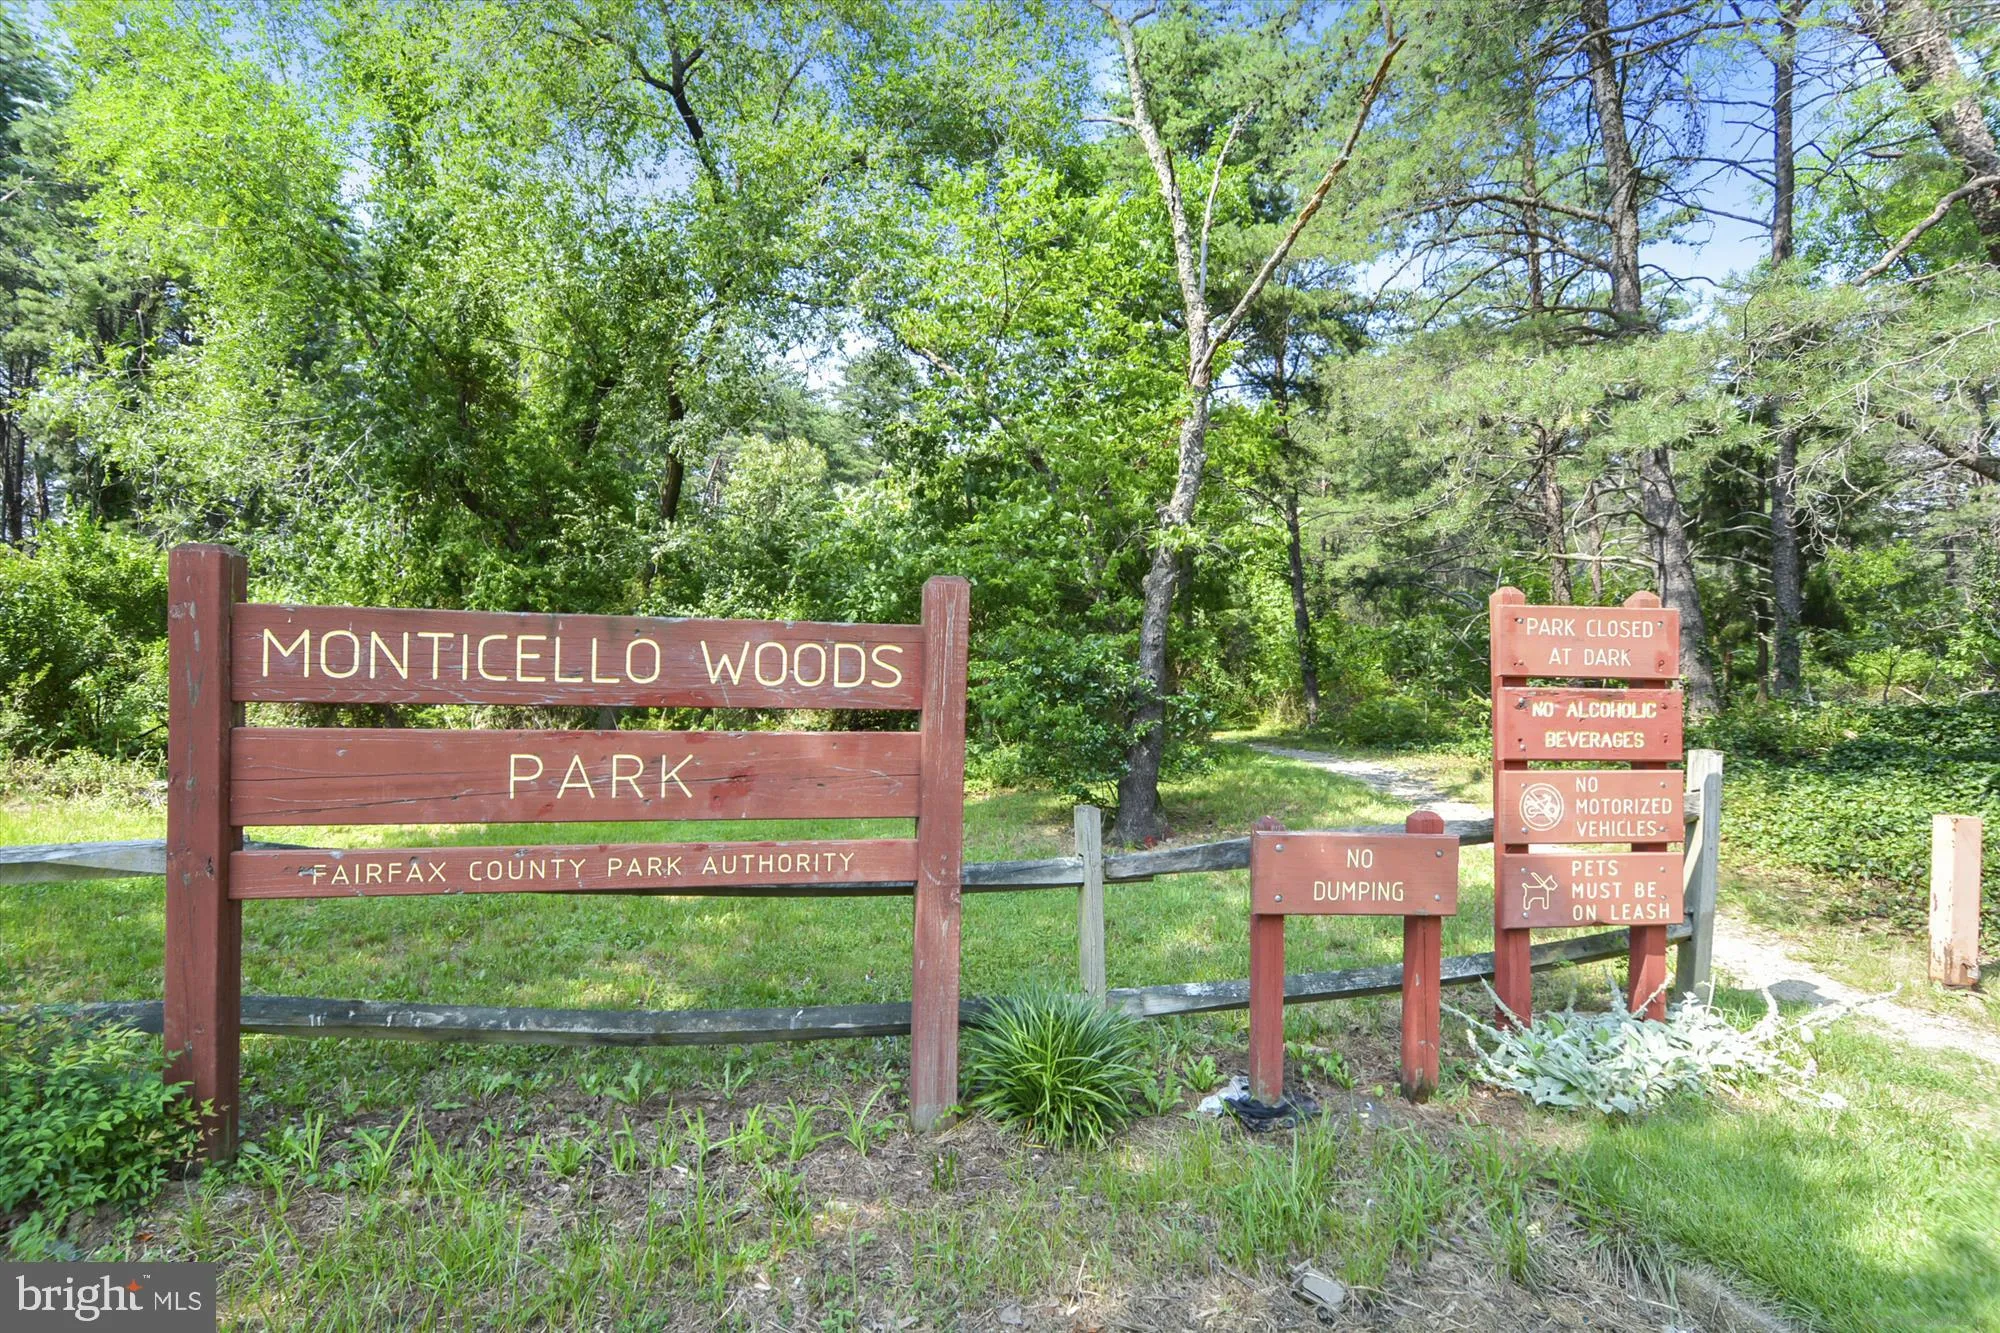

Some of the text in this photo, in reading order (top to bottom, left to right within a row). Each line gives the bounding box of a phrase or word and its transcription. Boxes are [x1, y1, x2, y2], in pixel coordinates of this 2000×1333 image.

[1526, 618, 1654, 638] PARK CLOSED
[261, 628, 903, 689] MONTICELLO WOODS
[1549, 647, 1631, 667] AT DARK
[1532, 702, 1657, 719] NO ALCOHOLIC
[1545, 731, 1645, 748] BEVERAGES
[508, 753, 694, 800] PARK
[1575, 777, 1599, 793] NO
[1576, 799, 1672, 815] MOTORIZED
[1577, 821, 1657, 837] VEHICLES
[1346, 849, 1374, 869] NO
[311, 852, 855, 886] FAIRFAX COUNTY PARK AUTHORITY
[1572, 860, 1619, 877] PETS
[1313, 881, 1404, 902] DUMPING
[1572, 881, 1656, 899] MUST BE
[1573, 903, 1670, 920] ON LEASH
